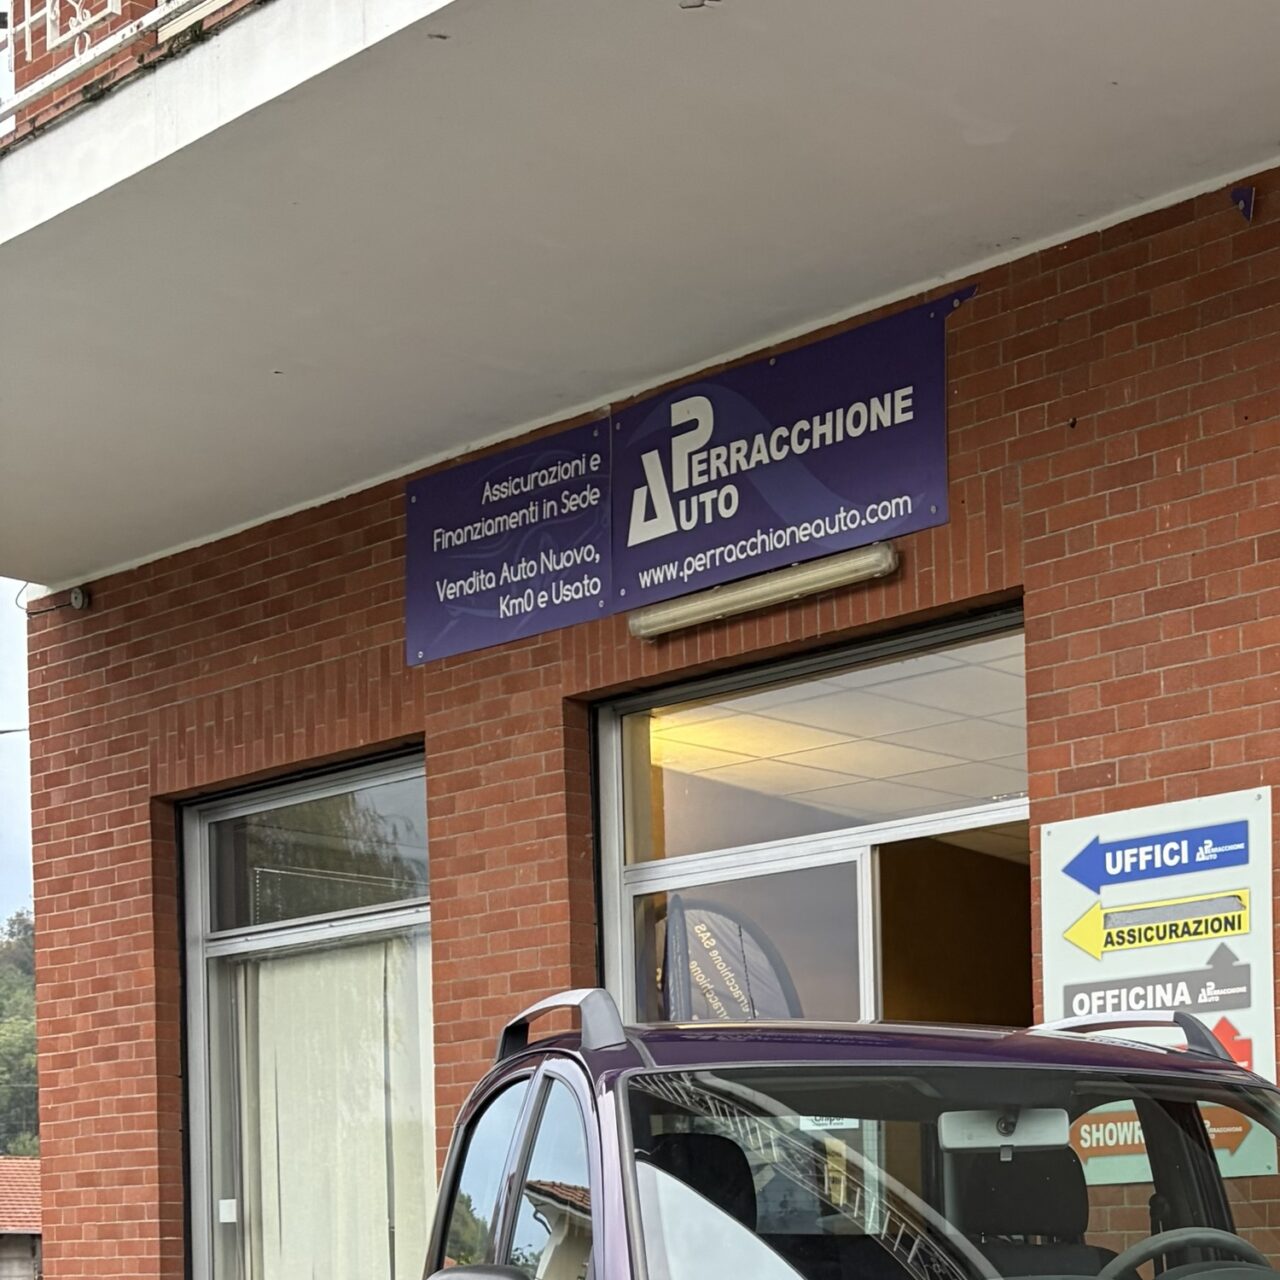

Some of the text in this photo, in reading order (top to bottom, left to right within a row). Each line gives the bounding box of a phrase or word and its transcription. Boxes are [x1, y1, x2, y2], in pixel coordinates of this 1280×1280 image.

[670, 386, 914, 492] PERRACCHIONE
[482, 454, 601, 505] Assicurazioni e
[627, 449, 739, 547] AUTO
[433, 486, 601, 552] Finanziamenti in Sede
[639, 493, 912, 589] www.perracchioneauto.com
[436, 545, 601, 602] Vendita Auto Nuovo,
[499, 576, 601, 619] Km0 e Usato
[1105, 840, 1188, 875] UFFICI
[1104, 913, 1242, 948] ASSICURAZIONI
[1073, 982, 1191, 1016] OFFICINA
[1080, 1121, 1146, 1148] SHOWR
